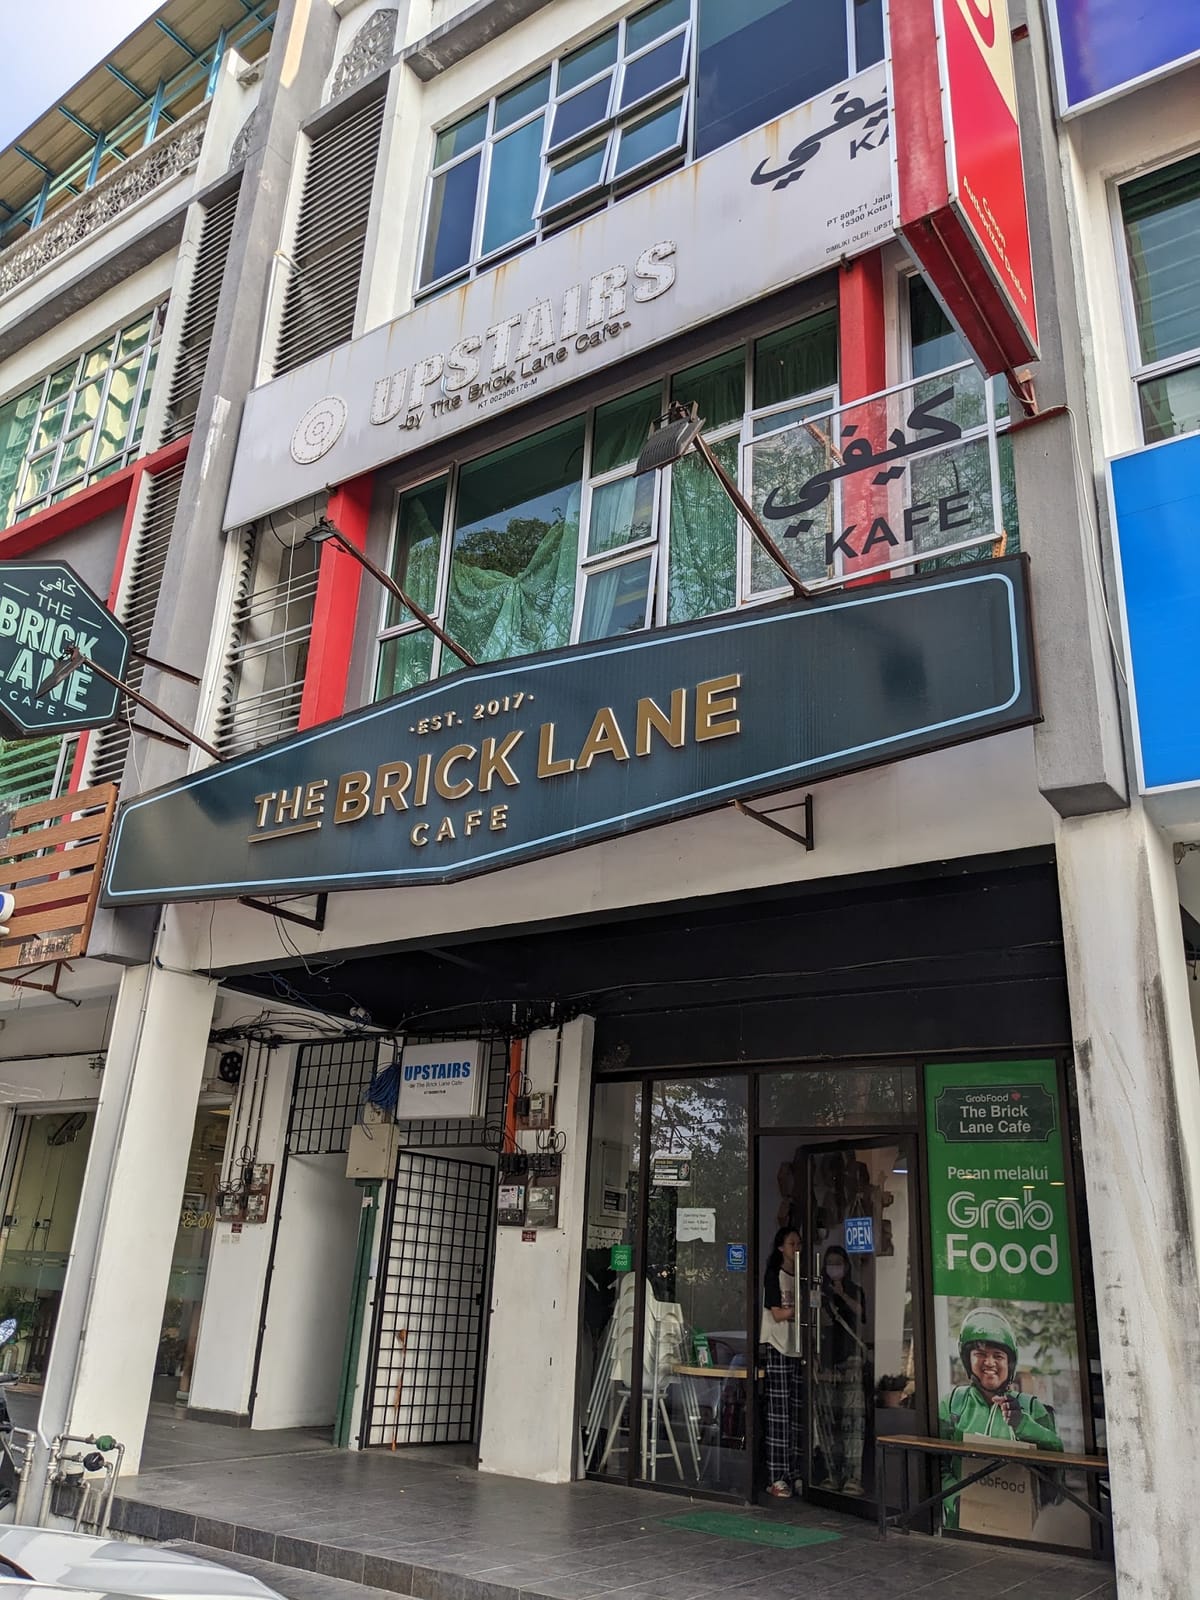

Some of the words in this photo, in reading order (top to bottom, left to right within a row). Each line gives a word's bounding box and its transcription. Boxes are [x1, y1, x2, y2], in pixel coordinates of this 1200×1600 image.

[826, 216, 839, 228] PT
[840, 203, 868, 221] 809-T1
[872, 192, 893, 206] Jala
[840, 213, 865, 229] 15300
[867, 203, 888, 217] Kota
[825, 238, 850, 254] DIMILIKI
[370, 239, 678, 426] UPSTAIRS
[430, 393, 463, 419] The
[467, 368, 516, 403] Brick
[520, 345, 569, 379] Lane
[477, 398, 488, 409] KT
[825, 489, 972, 566] KAFE
[36, 592, 73, 621] THE
[0, 596, 99, 674] BRICK
[0, 648, 93, 713] ANE
[9, 690, 56, 716] CAFE
[253, 778, 329, 829] THE
[333, 729, 525, 825] BRICK
[536, 673, 742, 779] LANE
[410, 803, 510, 847] CAFE
[404, 1061, 471, 1081] UPSTAIRS
[965, 1092, 1009, 1103] GrabFood
[959, 1105, 987, 1119] The
[990, 1104, 1029, 1118] Brick
[959, 1121, 994, 1134] Lane
[997, 1119, 1031, 1134] Cafe
[947, 1166, 991, 1181] Pesan
[994, 1165, 1049, 1181] melalui
[946, 1189, 1054, 1232] Grab
[846, 1226, 871, 1246] OPEN
[945, 1233, 1059, 1276] Food
[975, 1475, 1026, 1494] abFood
